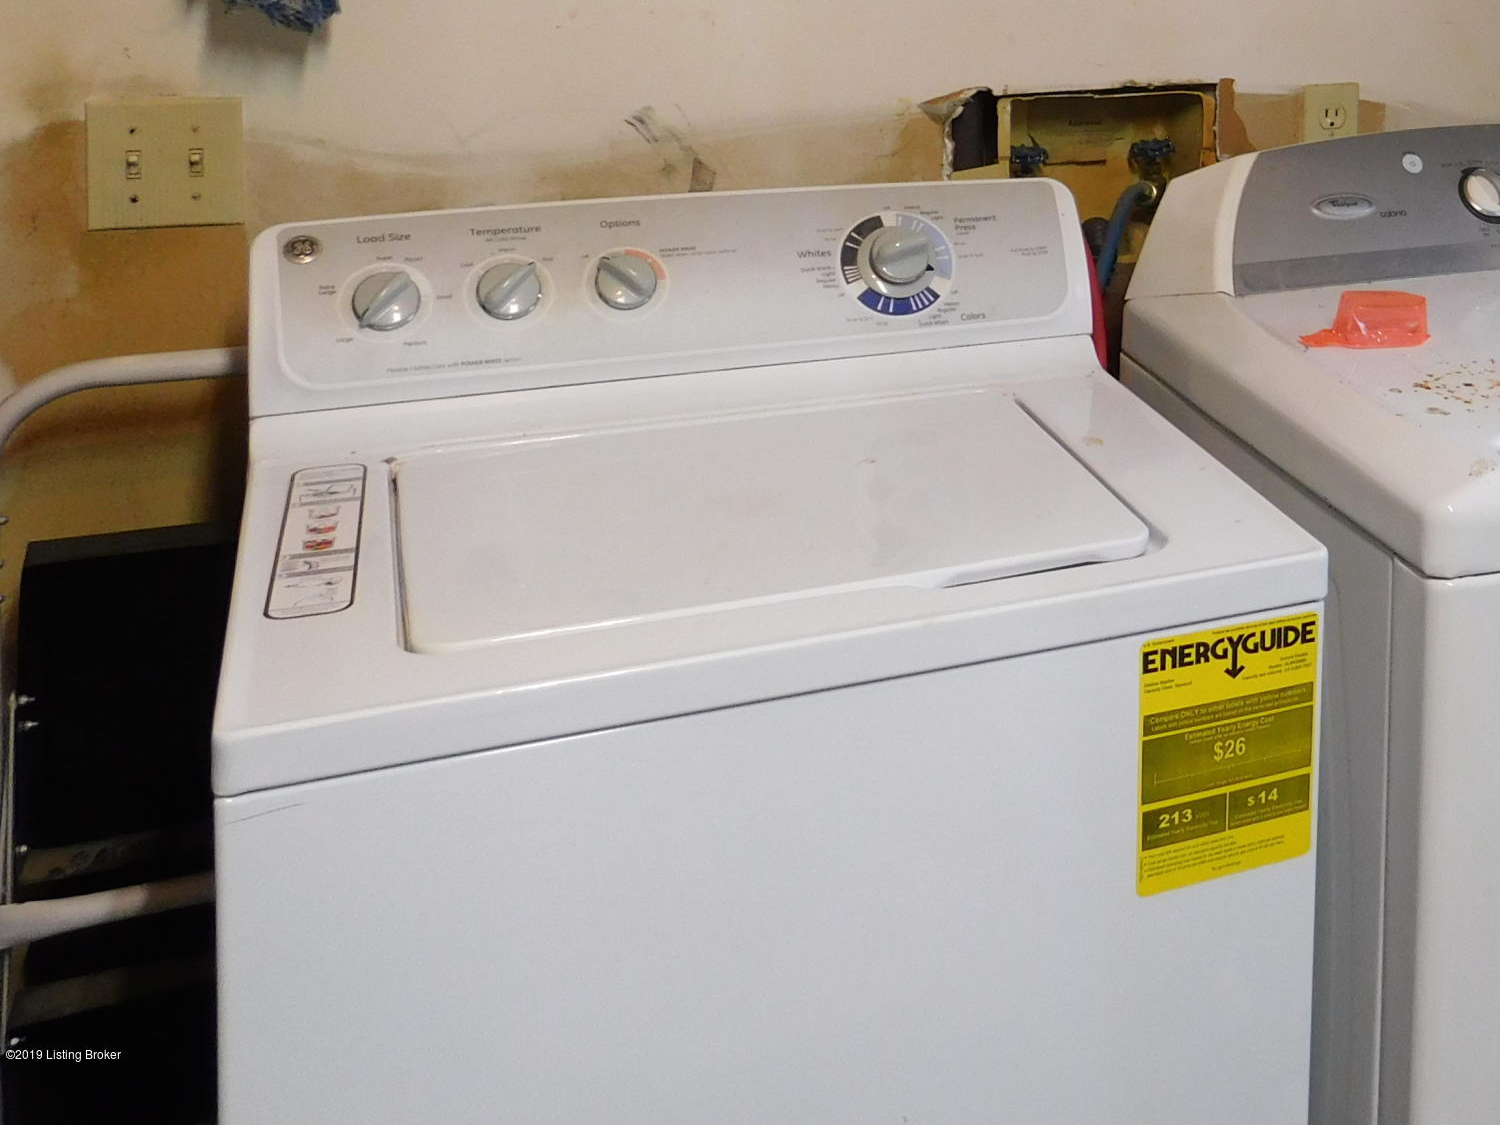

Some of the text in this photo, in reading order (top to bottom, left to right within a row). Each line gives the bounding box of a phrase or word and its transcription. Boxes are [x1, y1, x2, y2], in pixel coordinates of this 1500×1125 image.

[599, 218, 641, 230] Options
[470, 226, 541, 237] Temperature
[356, 232, 412, 244] Load Size
[797, 249, 832, 259] Whites
[961, 312, 986, 322] Colors
[1142, 621, 1316, 678] ENERGYGUIDE
[1213, 737, 1246, 762] $26
[1158, 808, 1193, 829] 213
